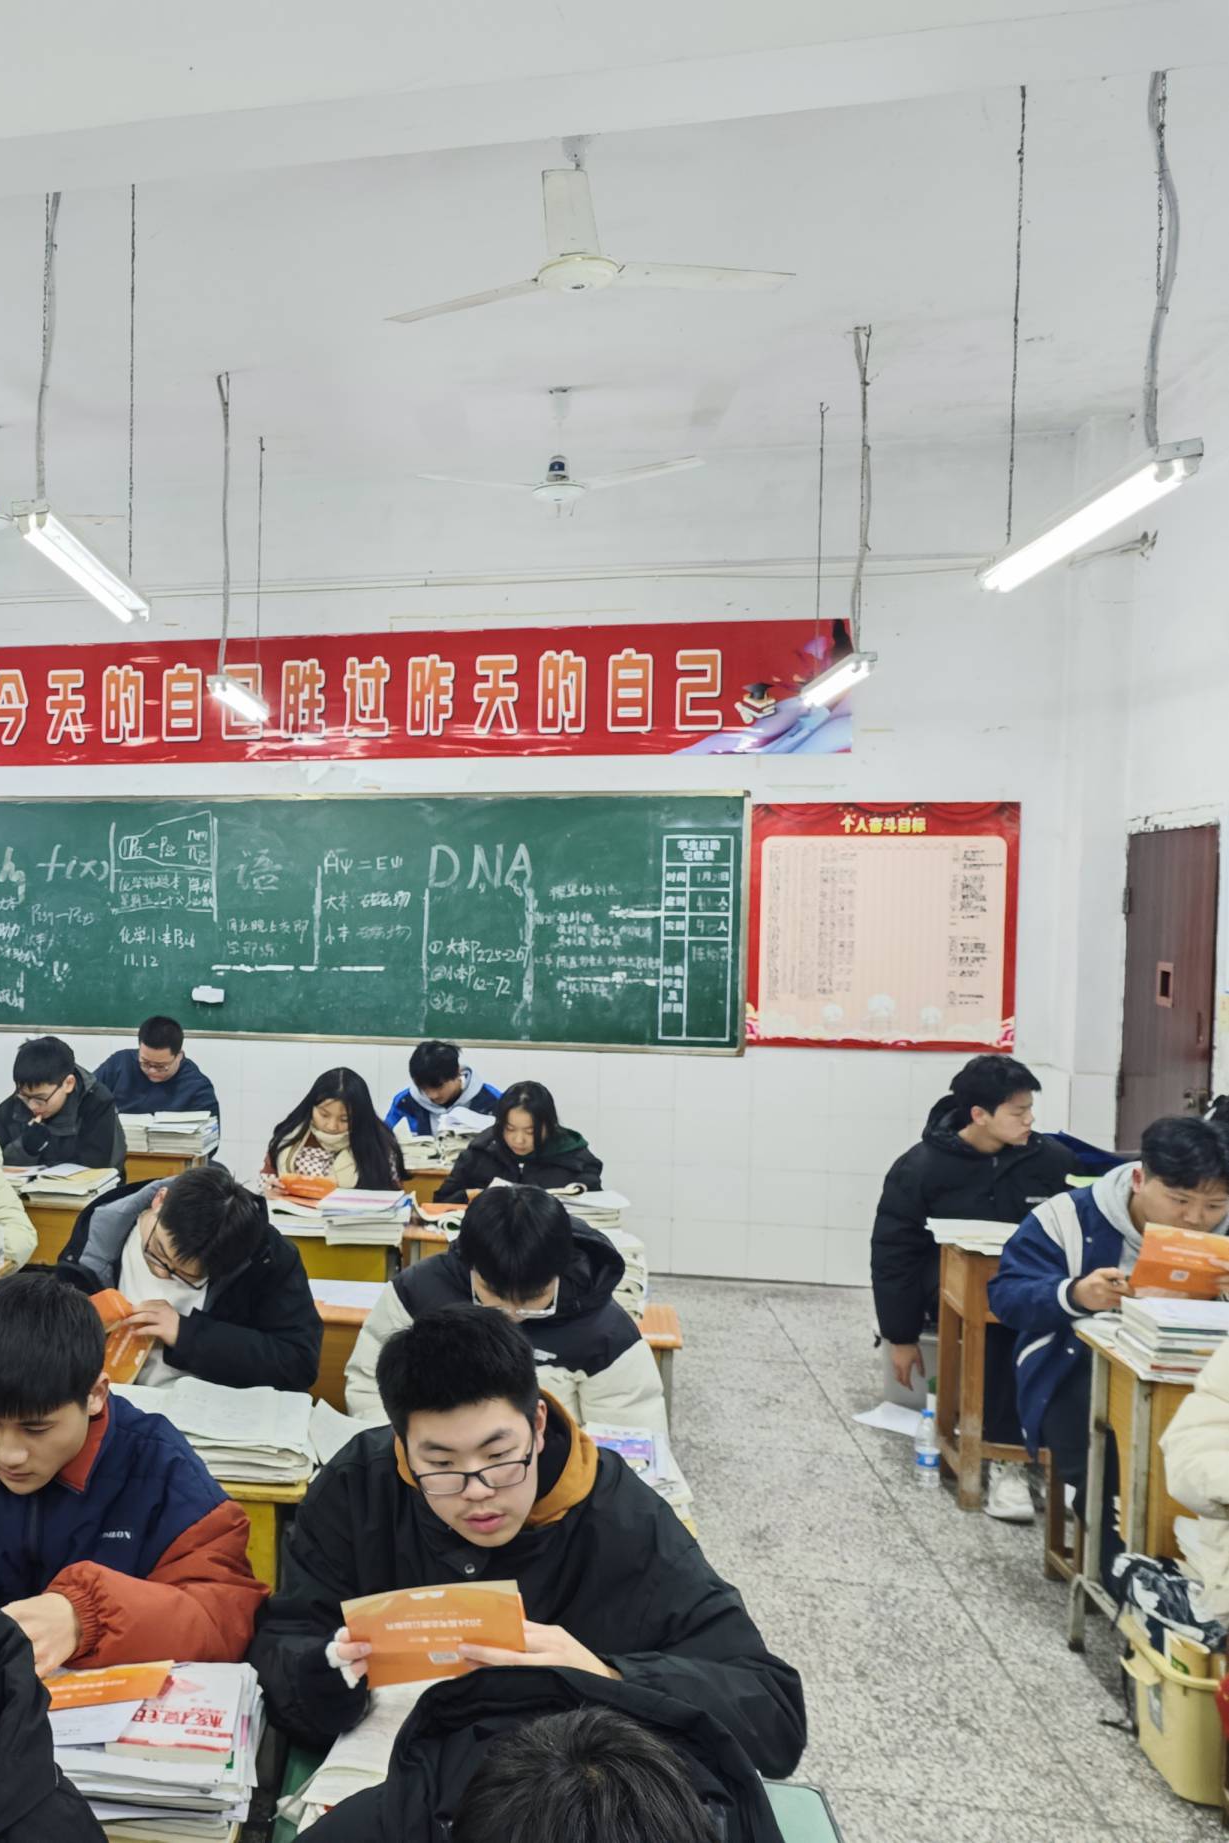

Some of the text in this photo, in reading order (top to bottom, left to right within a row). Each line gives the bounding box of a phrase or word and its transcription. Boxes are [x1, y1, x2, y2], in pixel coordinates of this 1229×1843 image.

[840, 815, 927, 834] 个人奋斗目标
[677, 839, 721, 851] 学生出勤
[428, 843, 533, 889] DNA
[665, 871, 687, 882] 时间
